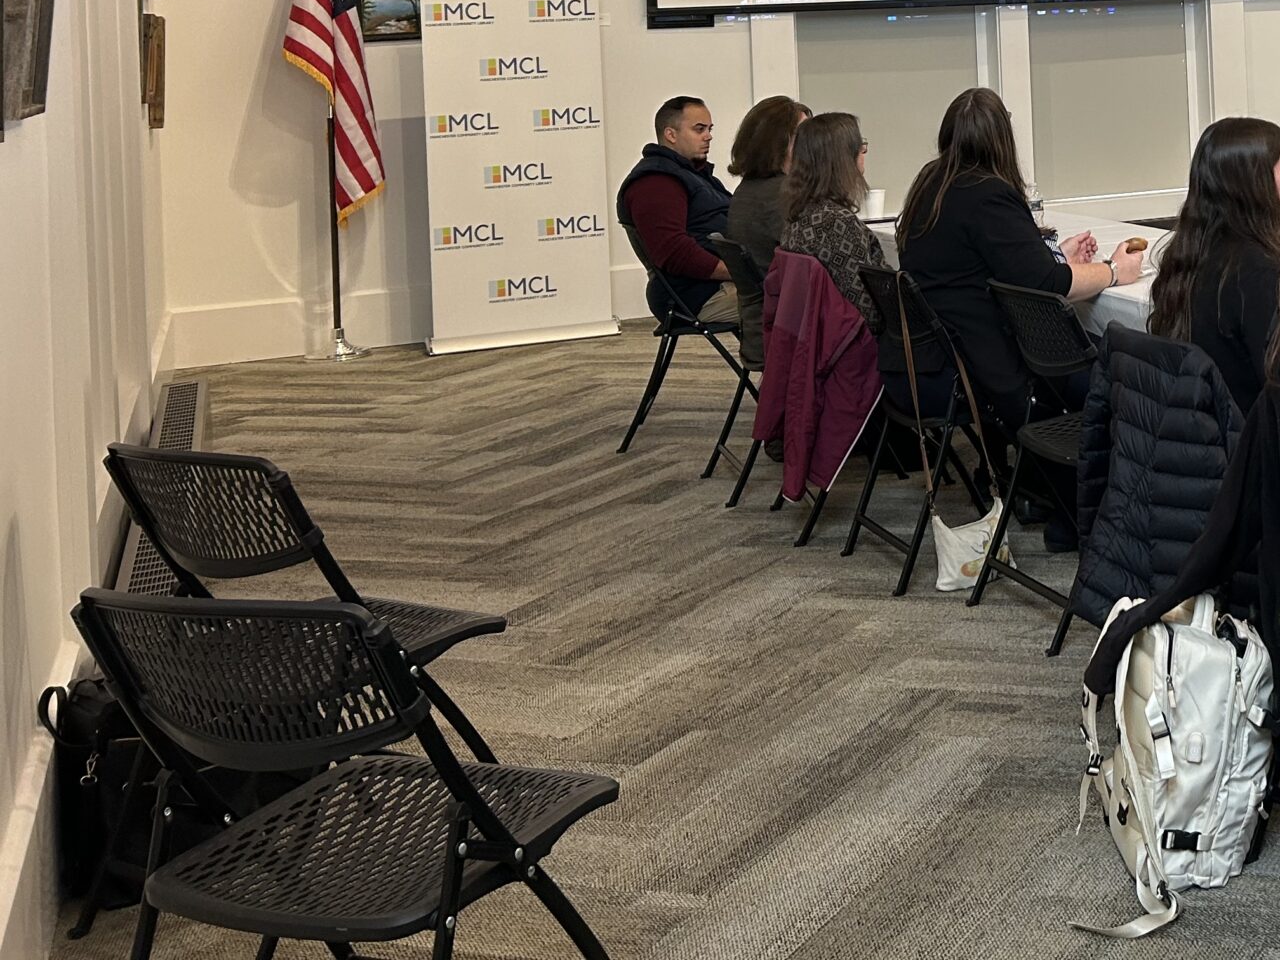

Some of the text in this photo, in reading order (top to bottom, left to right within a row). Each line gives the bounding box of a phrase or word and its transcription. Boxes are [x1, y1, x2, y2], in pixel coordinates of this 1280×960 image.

[444, 2, 494, 20] MCL
[547, 0, 595, 16] MCL
[499, 57, 548, 75] MCL
[449, 113, 499, 133] MCL
[552, 107, 600, 125] MCL
[503, 163, 552, 183] MCL
[453, 224, 503, 244] MCL
[557, 215, 604, 235] MCL
[508, 276, 557, 296] MCL
